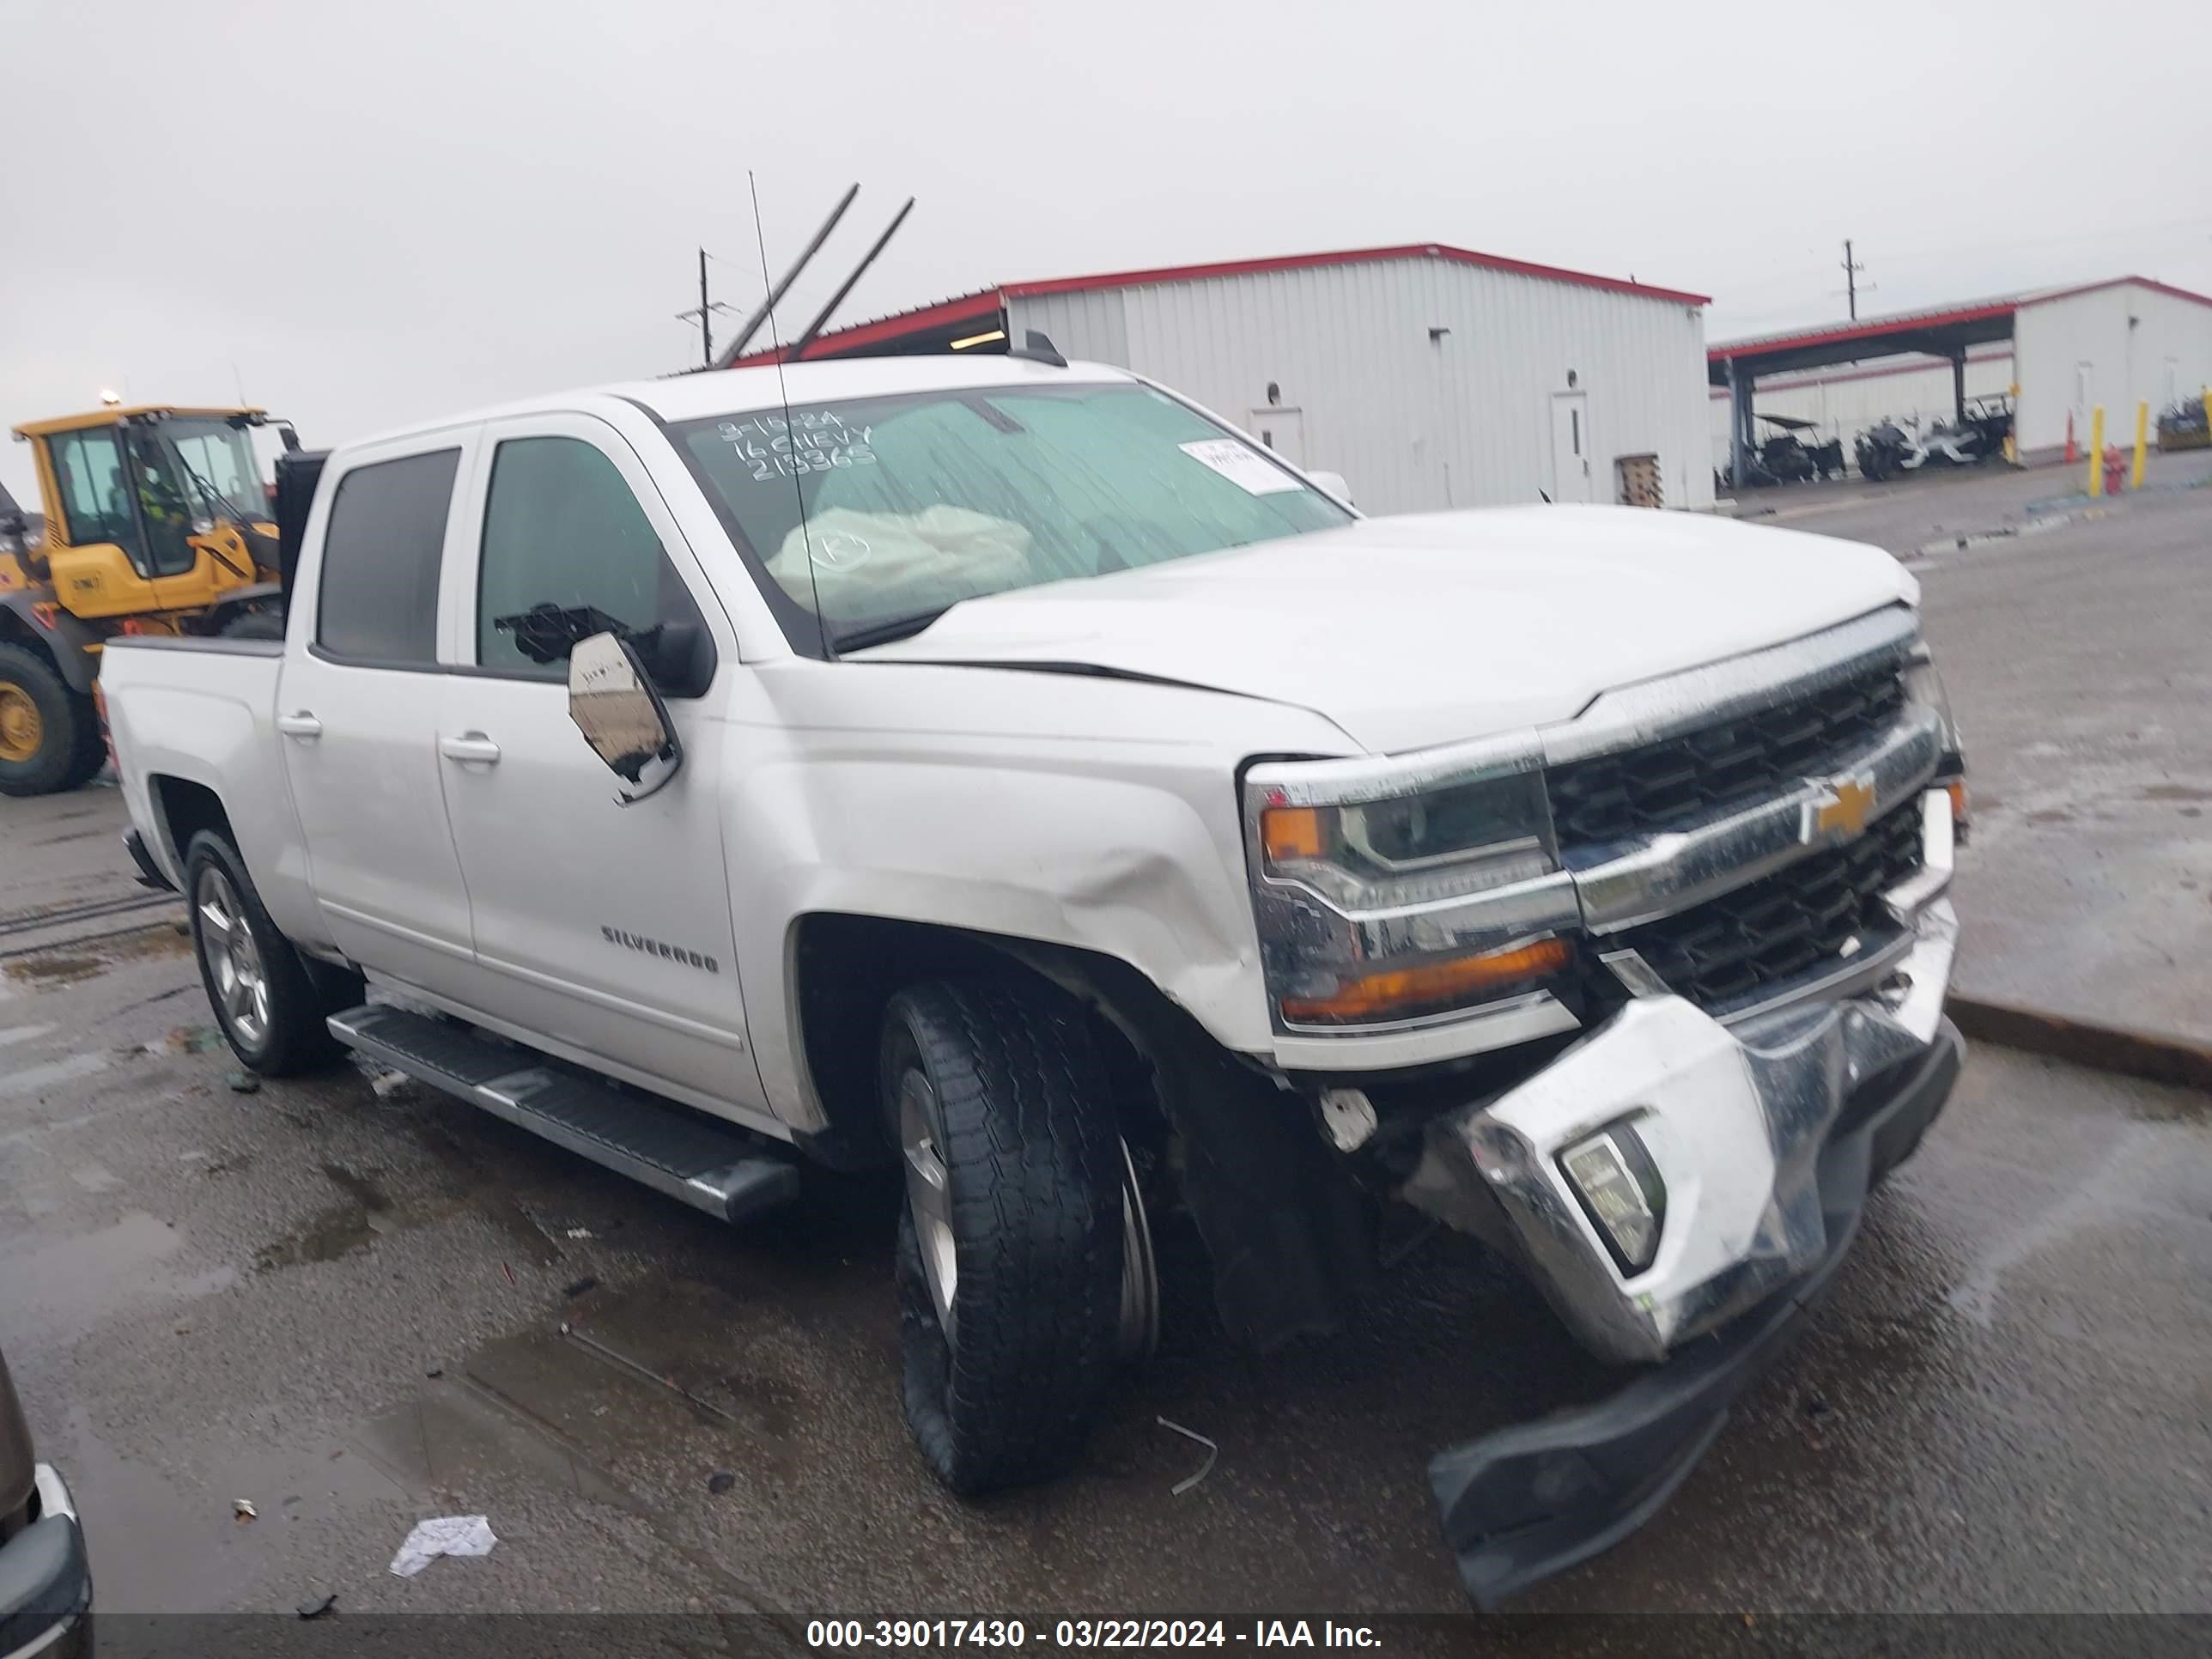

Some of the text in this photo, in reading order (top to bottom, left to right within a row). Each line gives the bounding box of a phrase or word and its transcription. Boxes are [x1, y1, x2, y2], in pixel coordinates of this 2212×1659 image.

[734, 425, 872, 462] 16 CHEVY
[746, 445, 877, 482] 213365
[601, 925, 720, 974] SILVERADO
